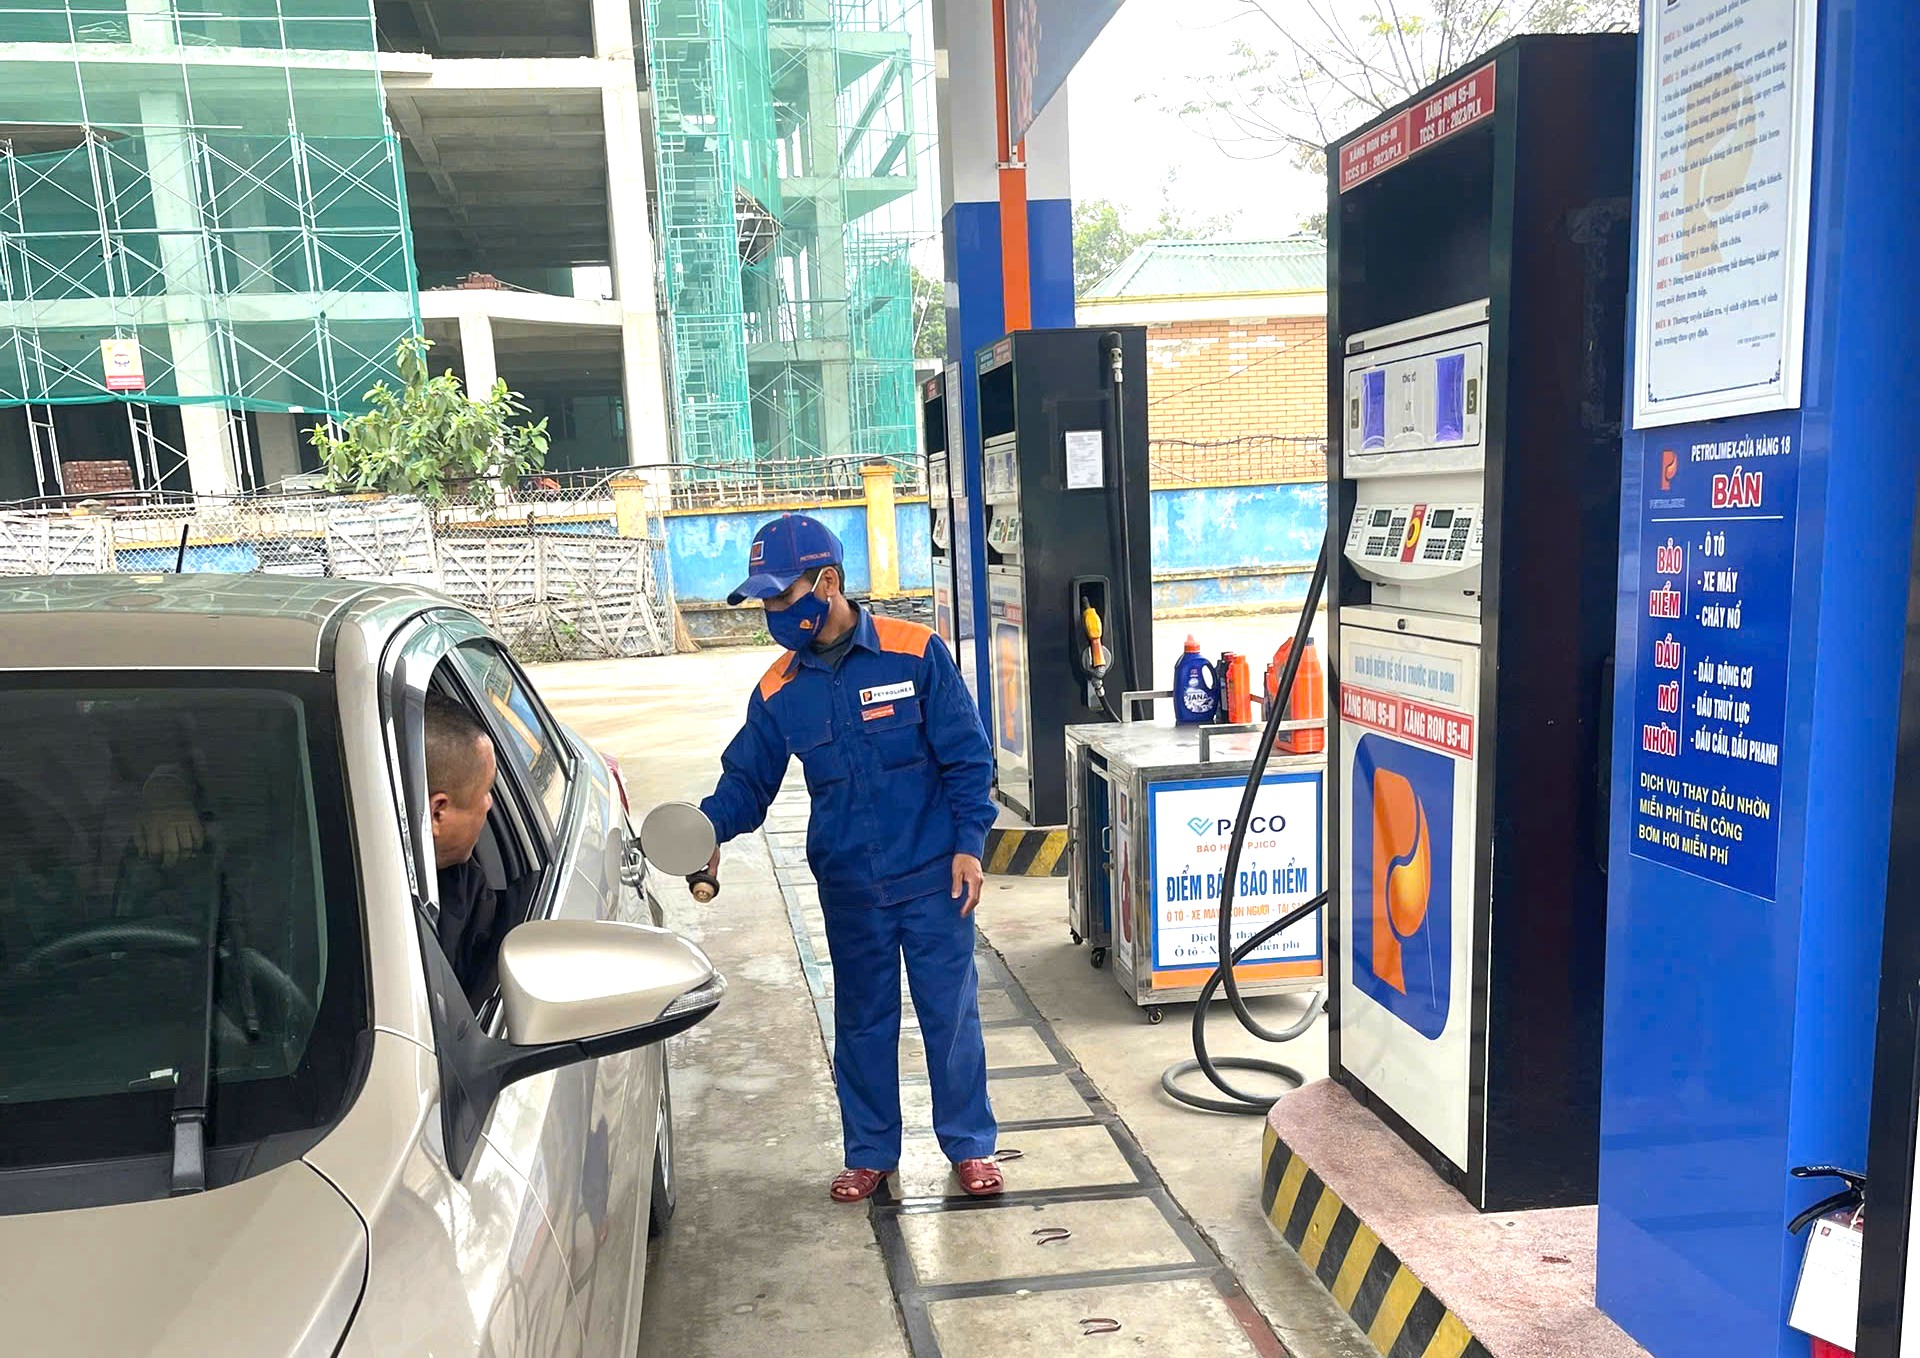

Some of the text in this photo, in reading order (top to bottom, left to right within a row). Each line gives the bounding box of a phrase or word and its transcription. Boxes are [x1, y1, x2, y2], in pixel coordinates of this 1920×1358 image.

[1756, 434, 1779, 456] HÀNG
[1781, 436, 1791, 454] 18
[1712, 466, 1763, 508] BÁN
[1656, 538, 1682, 574] BẢO
[1705, 531, 1725, 556] Ô TÔ
[1703, 568, 1738, 593] XE MÁY
[1650, 580, 1681, 618] HIỂM
[1702, 600, 1742, 629] CHÁY NỔ
[1655, 633, 1680, 669] DẦU
[1698, 656, 1753, 690] DẦU ĐỘNG CƠ
[1343, 690, 1396, 729] XĂNG RON 95-III
[1657, 681, 1679, 713] MỠ
[1696, 690, 1712, 718] DẦU
[1734, 700, 1750, 728] LỰC
[1404, 705, 1470, 751] XĂNG RON 95-III
[1643, 722, 1676, 757] NHỜN
[1695, 724, 1711, 752] DẦU
[1731, 731, 1748, 761] DẦU
[1749, 739, 1778, 766] PHANH
[1640, 772, 1770, 820] DỊCH VỤ THAY DẦU NHỜN
[1217, 815, 1286, 836] PCO
[1640, 794, 1743, 841] MIỄN PHÍ TIỀN CÔNG
[1196, 842, 1217, 853] BẢO
[1248, 840, 1276, 849] PJICO
[1639, 823, 1729, 865] BƠM HƠI MIỄN PHÍ
[1167, 857, 1308, 902] ĐIỂM BÁ BẢO HIỂM
[1192, 910, 1201, 920] XE
[1231, 906, 1244, 917] ON
[1175, 945, 1184, 957] Ô
[1188, 946, 1198, 956] tô
[1192, 933, 1215, 944] Dịch
